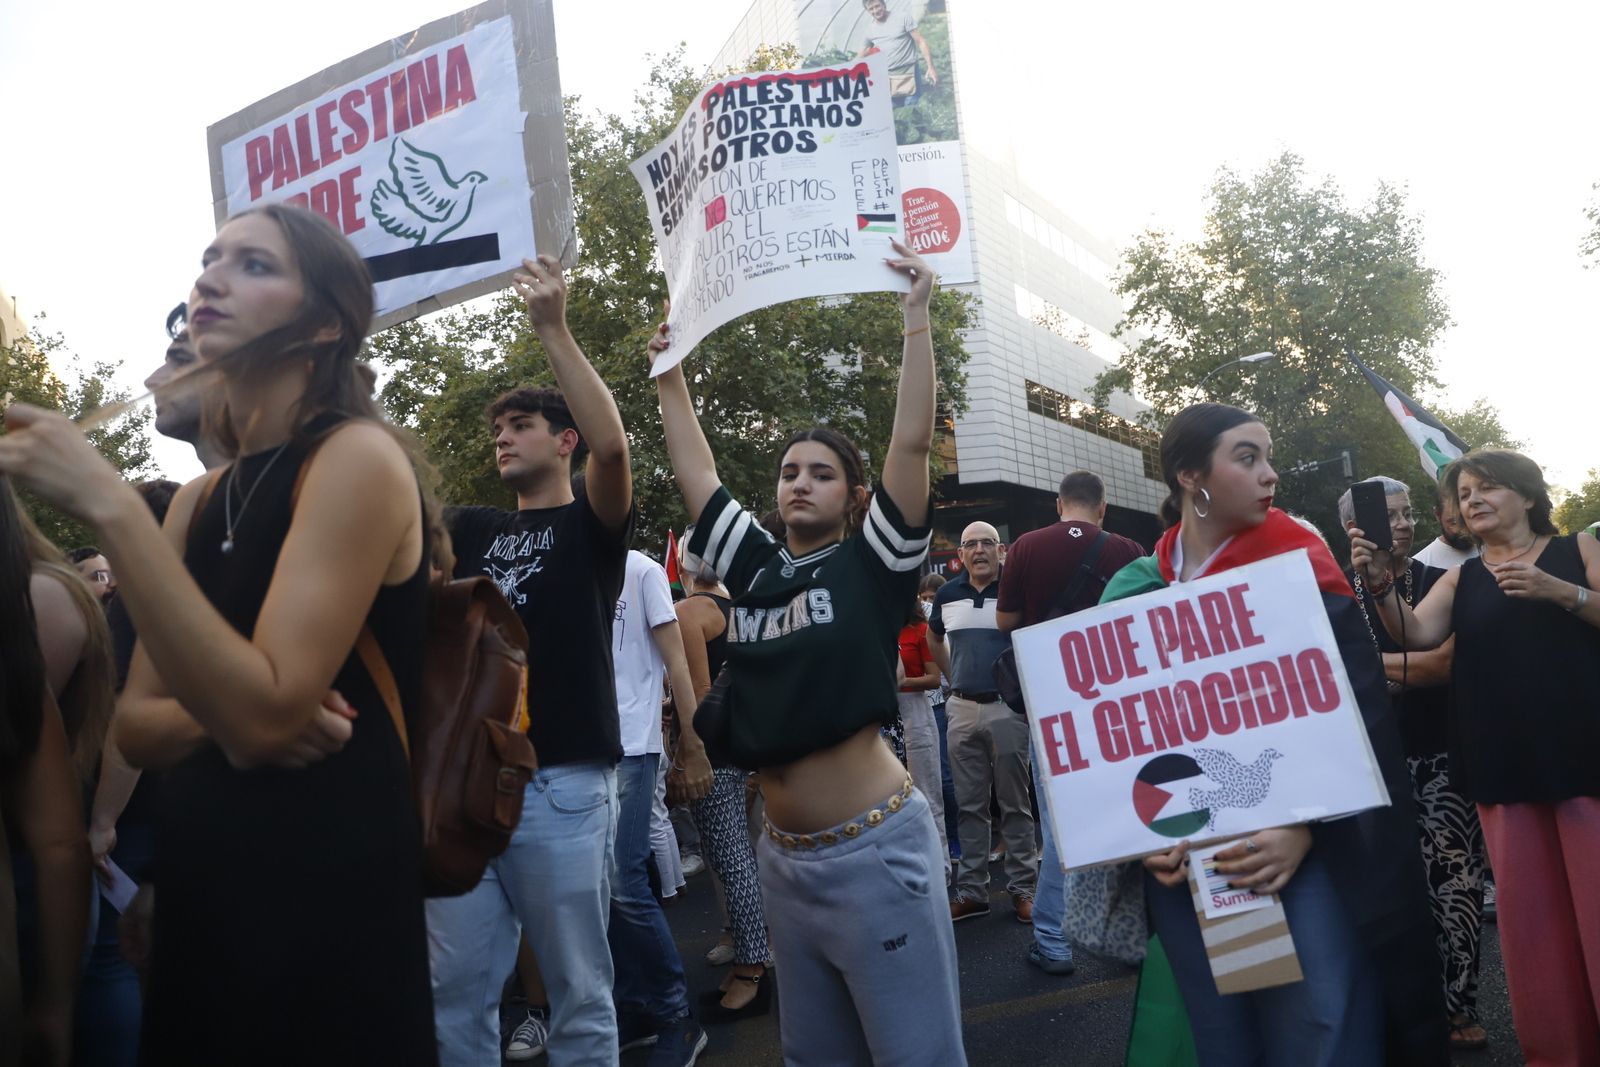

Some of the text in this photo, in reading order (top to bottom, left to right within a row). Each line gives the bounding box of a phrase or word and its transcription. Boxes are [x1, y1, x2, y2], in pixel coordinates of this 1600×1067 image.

[245, 43, 477, 202] PALESTINA
[646, 72, 870, 190] HOY ES PALESTINA
[703, 100, 863, 151] PODRIAMOS
[661, 194, 685, 237] SER
[685, 130, 817, 209] NOSOTROS
[730, 177, 836, 217] QUEREMOS
[749, 160, 767, 183] DE
[745, 211, 775, 240] EL
[907, 195, 925, 207] Trae
[910, 211, 940, 228] Cajasur
[716, 236, 780, 278] OTROS
[786, 222, 850, 253] ESTÁN
[1059, 583, 1264, 700] QUE PARE
[1040, 647, 1341, 776] EL GENOCIDIO
[1212, 892, 1260, 908] Suma
